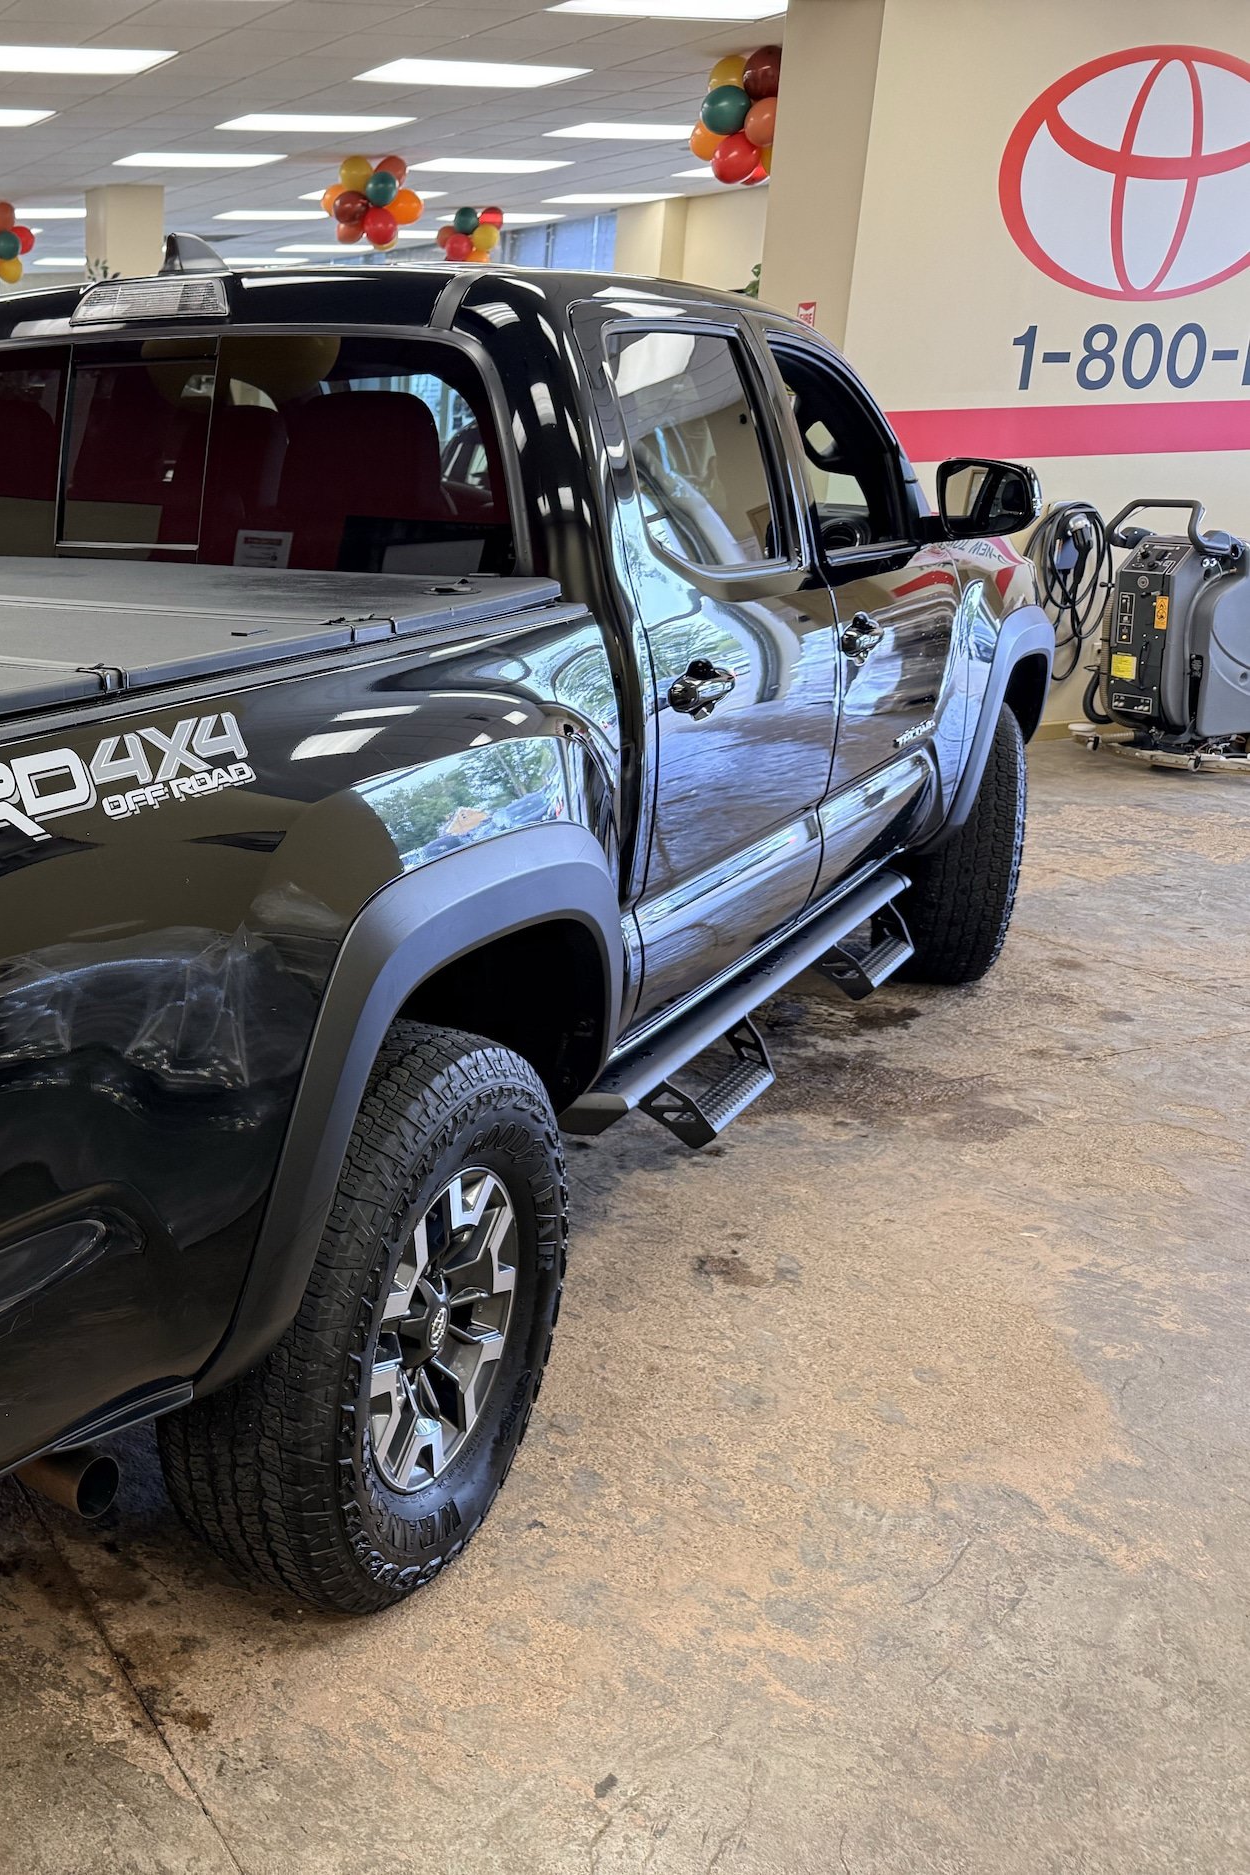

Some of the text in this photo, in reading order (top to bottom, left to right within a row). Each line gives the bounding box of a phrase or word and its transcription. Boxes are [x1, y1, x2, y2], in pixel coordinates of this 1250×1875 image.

[1012, 322, 1250, 391] 1-800-
[101, 761, 257, 821] OFF ROAD
